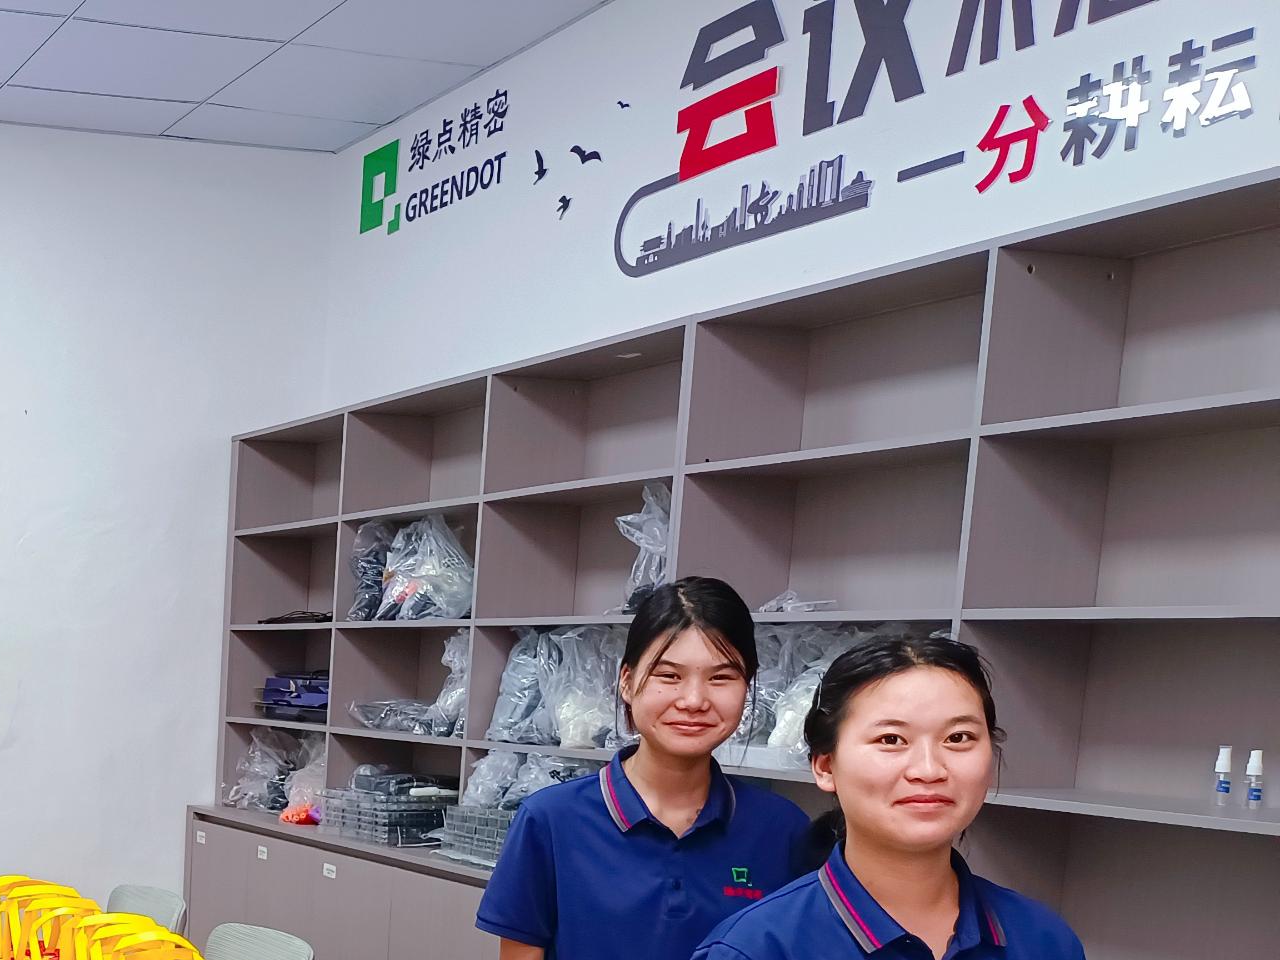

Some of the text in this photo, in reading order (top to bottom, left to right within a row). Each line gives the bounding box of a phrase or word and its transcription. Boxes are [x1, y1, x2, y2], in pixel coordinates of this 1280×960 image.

[408, 89, 510, 172] 绿点精密
[897, 27, 1257, 194] 一分耕耘
[405, 151, 507, 222] GREENDOT
